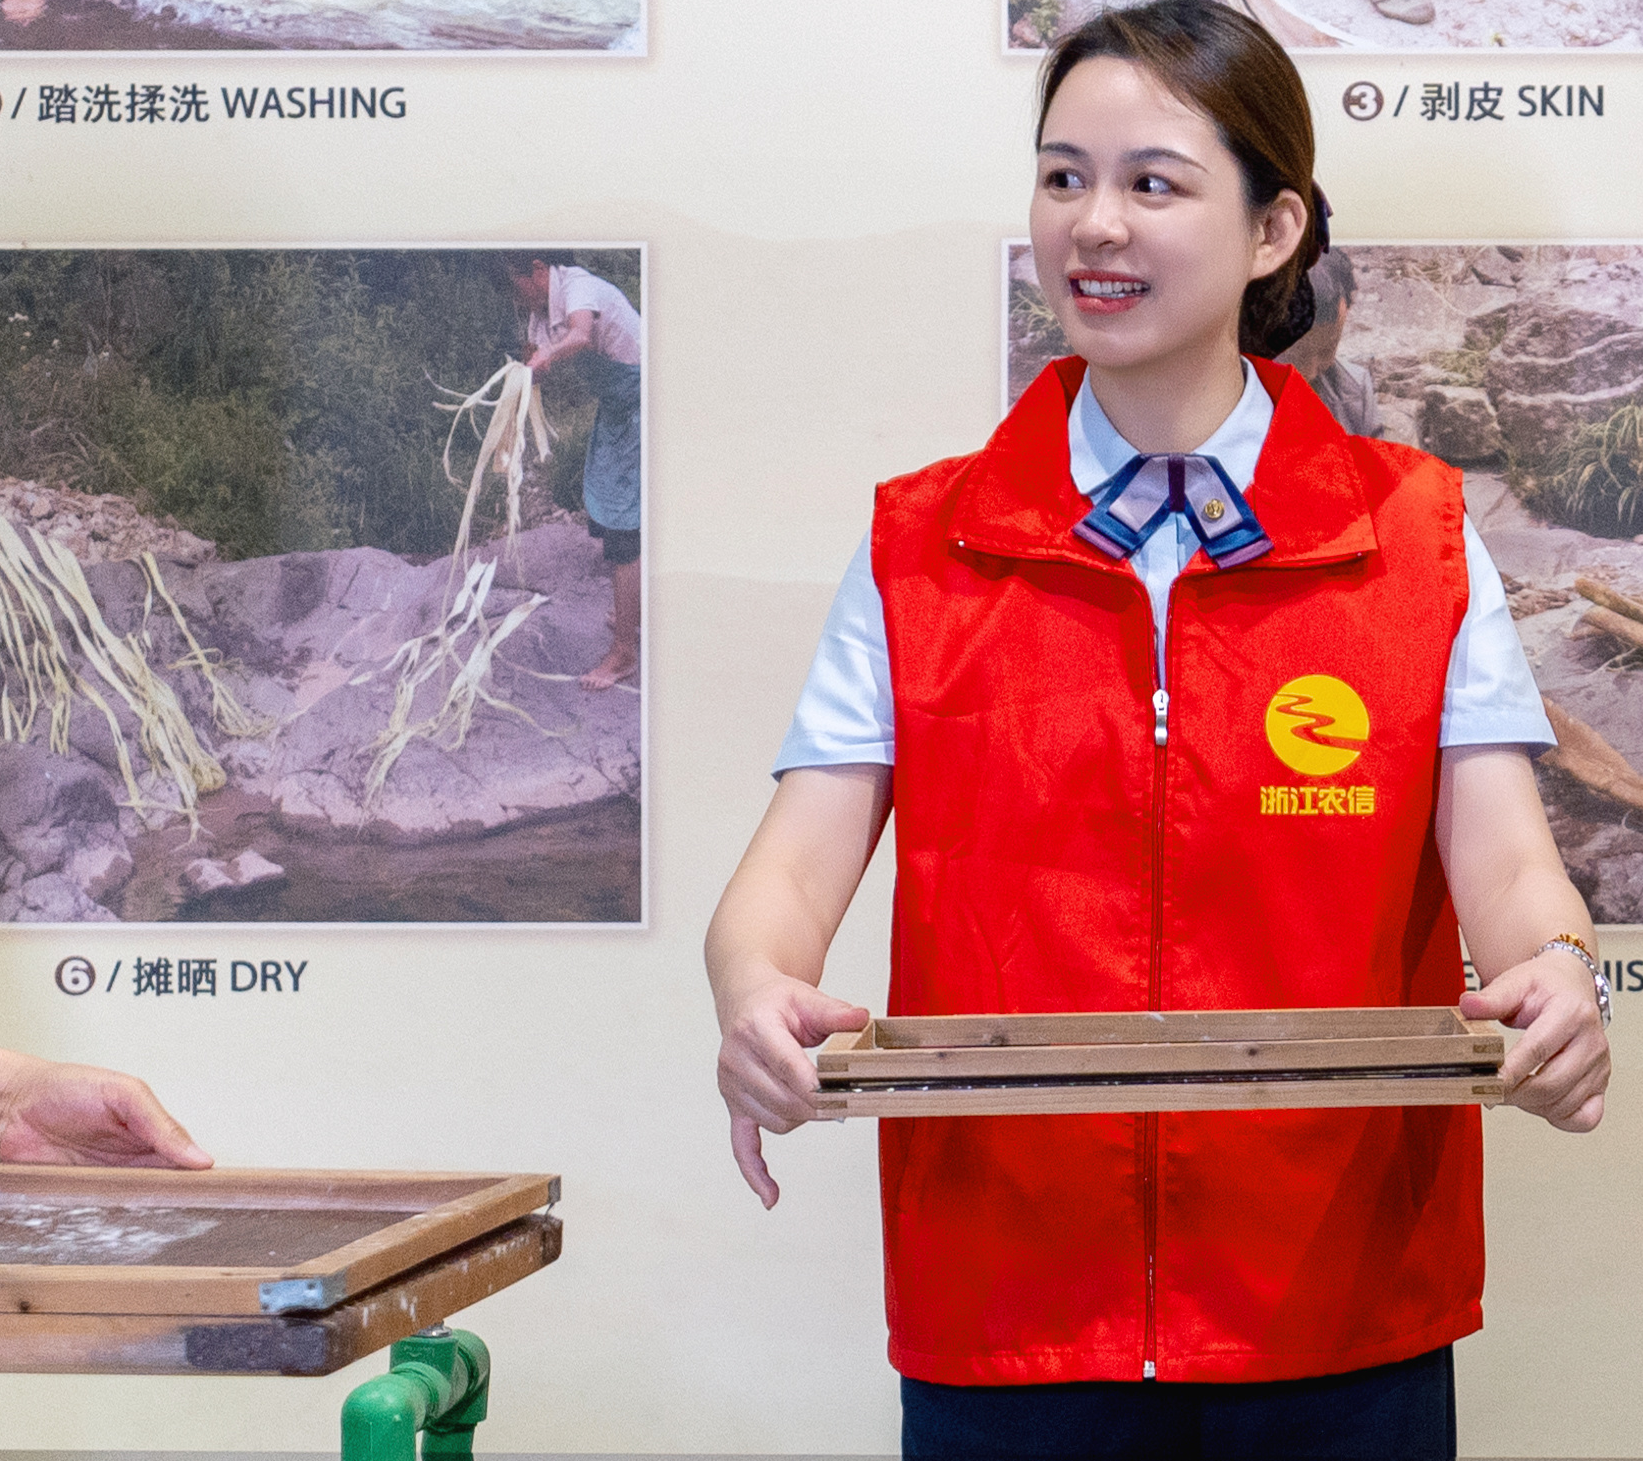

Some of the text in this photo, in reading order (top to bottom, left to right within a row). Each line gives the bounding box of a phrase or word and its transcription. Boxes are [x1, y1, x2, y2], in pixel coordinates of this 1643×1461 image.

[38, 83, 210, 125] 踏洗揉洗
[221, 86, 408, 120] WASHING
[1420, 82, 1505, 122] 剥皮
[1517, 85, 1605, 117] SKIN
[1260, 786, 1376, 816] 浙江农信
[133, 956, 218, 997] 摊晒
[230, 959, 309, 992] DRY
